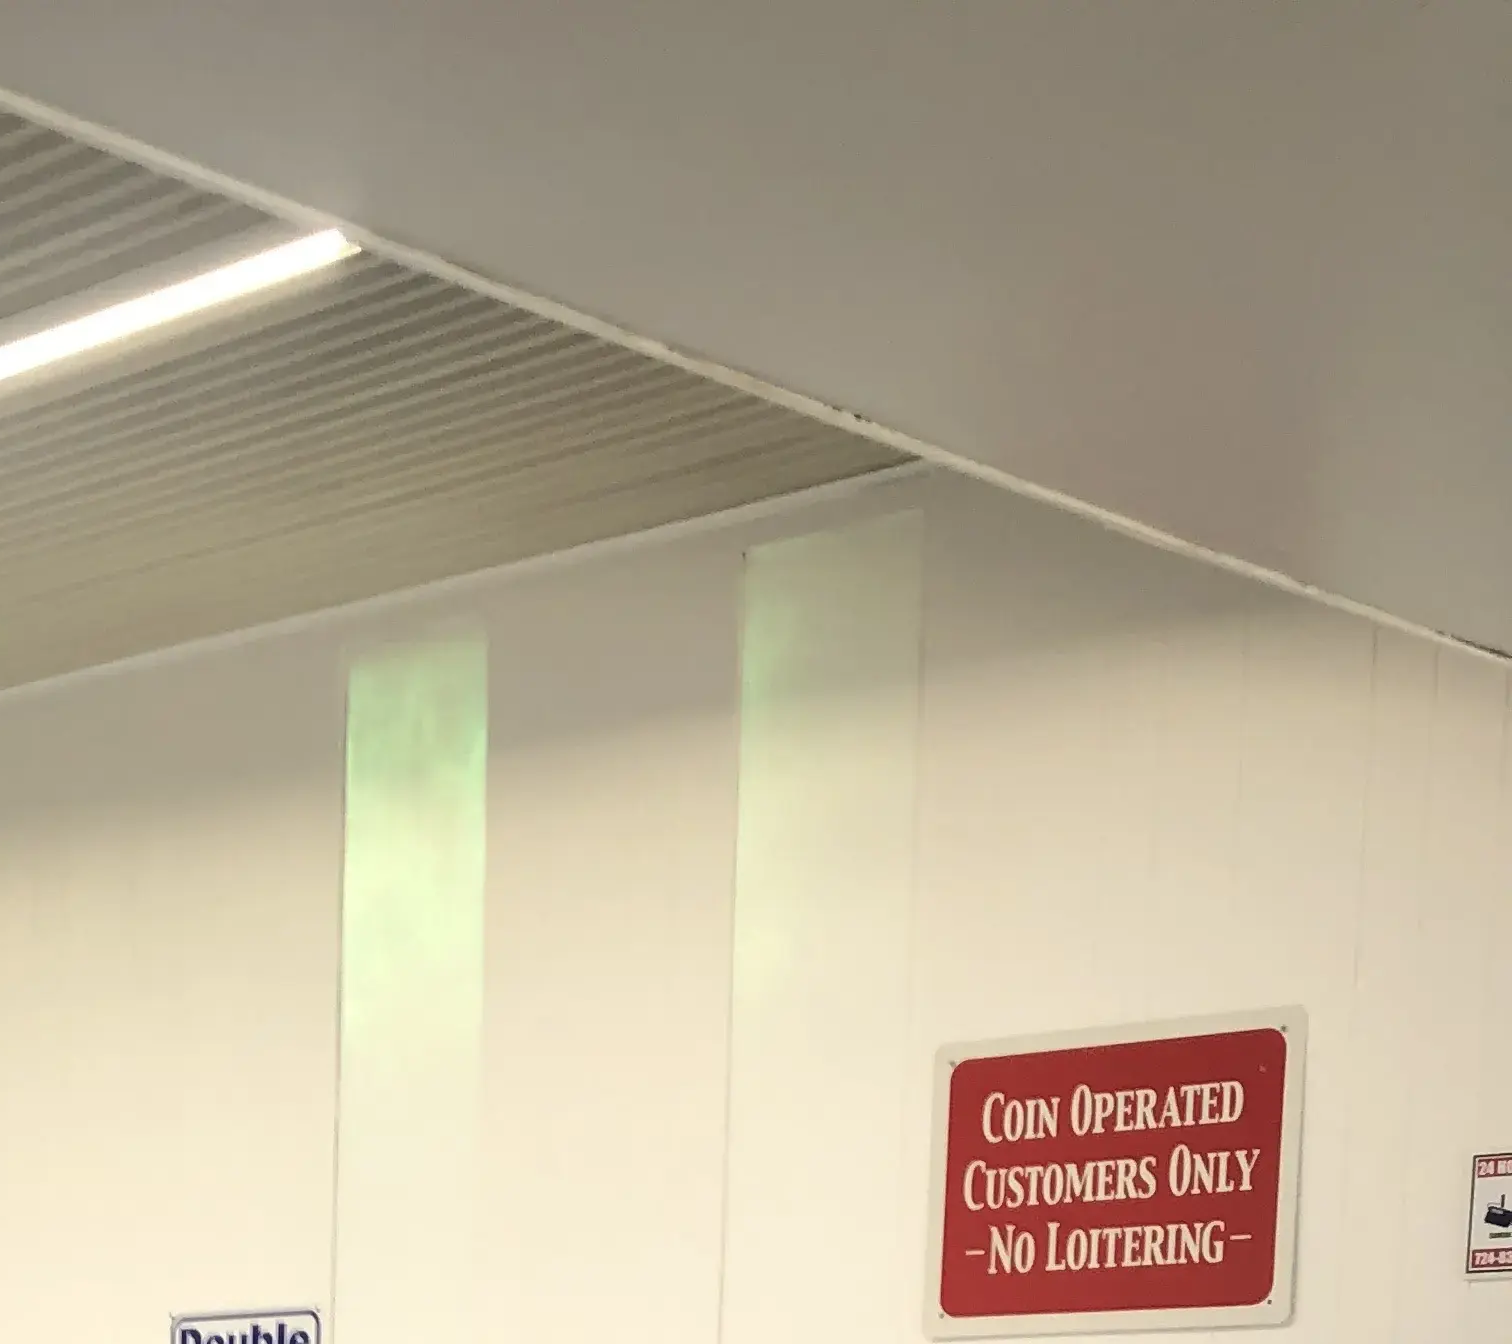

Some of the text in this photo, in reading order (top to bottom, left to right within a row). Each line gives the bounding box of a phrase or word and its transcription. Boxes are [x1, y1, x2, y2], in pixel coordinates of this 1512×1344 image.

[982, 1080, 1244, 1143] COIN OPERATED
[962, 1143, 1260, 1211] CUSTOMERS ONLY
